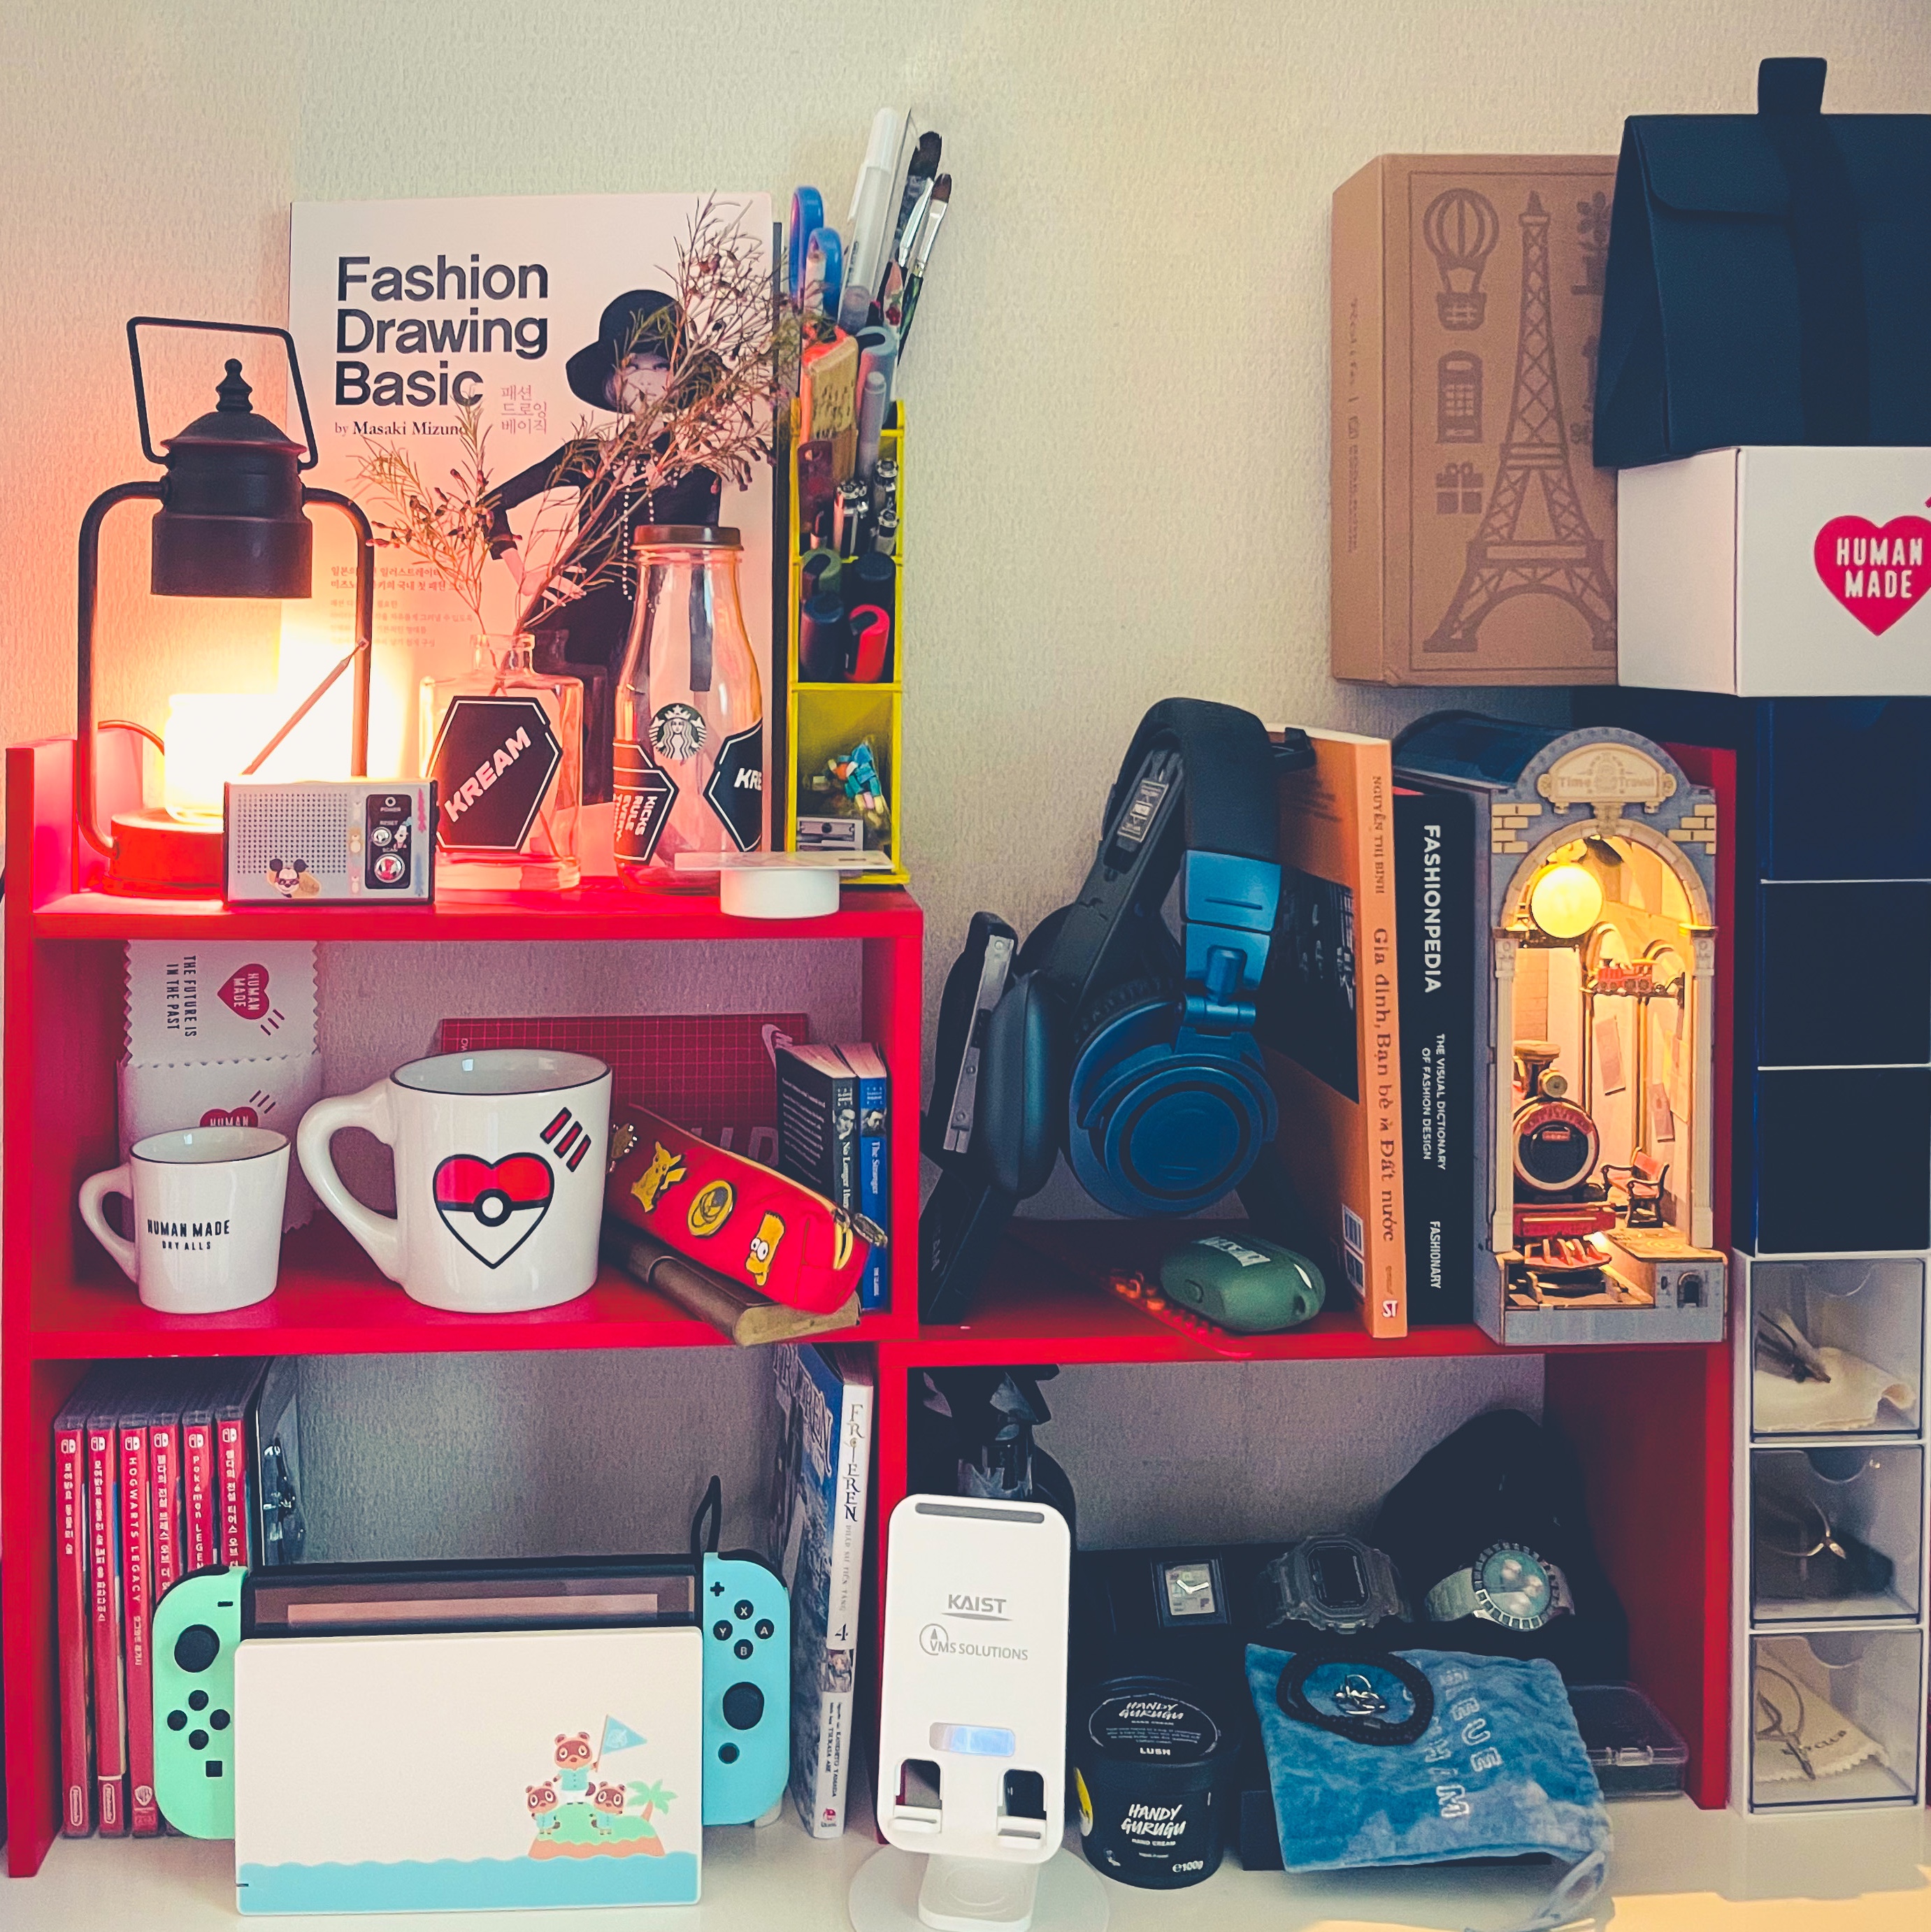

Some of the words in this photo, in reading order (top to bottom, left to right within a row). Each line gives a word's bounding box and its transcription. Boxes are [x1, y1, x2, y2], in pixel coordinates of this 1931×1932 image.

[338, 254, 549, 302] Fashion
[337, 308, 548, 360] Drawing
[336, 361, 483, 407] Basic
[501, 384, 531, 401] 패션
[501, 401, 547, 417] 드로잉
[335, 422, 348, 437] by
[353, 421, 406, 435] Masaki
[501, 418, 547, 435] 베이직
[1837, 538, 1923, 566] HUMAN
[1845, 570, 1912, 598] MADE
[443, 726, 533, 823] KREAM
[624, 795, 644, 831] RULE
[635, 795, 658, 836] KICKS
[1423, 825, 1442, 993] FASHIONPEDIA
[166, 963, 179, 975] IN
[183, 956, 196, 975] THE
[166, 979, 180, 1000] THE
[183, 979, 197, 1023] FUTURE
[233, 978, 246, 1008] MADE
[247, 972, 260, 1011] HUMAN
[166, 1004, 180, 1030] PAST
[184, 1027, 197, 1037] IS
[1436, 1033, 1445, 1055] THE
[1374, 1033, 1391, 1076] Bạn
[1421, 1047, 1431, 1064] OF
[1436, 1058, 1446, 1098] VISUAL
[1422, 1066, 1431, 1116] FASHION
[1423, 1118, 1432, 1160] DESIGN
[1436, 1101, 1447, 1170] DICTIONARY
[148, 1219, 187, 1237] HUMAN
[192, 1220, 230, 1237] MADE
[185, 1241, 211, 1250] ALLS
[1430, 1220, 1442, 1289] FASHIONARY
[1382, 1300, 1398, 1318] ST
[843, 1404, 865, 1522] FRIEREN
[129, 1457, 138, 1538] HOGWARTS
[192, 1455, 203, 1518] Pokémon
[227, 1505, 238, 1534] 티어스
[228, 1538, 238, 1557] 오브
[131, 1546, 141, 1602] LEGACY
[740, 1606, 748, 1616] X
[948, 1594, 1007, 1614] KAIST
[719, 1627, 726, 1637] Y
[760, 1626, 768, 1635] A
[835, 1623, 849, 1642] 4
[740, 1646, 747, 1656] B
[930, 1639, 956, 1654] VMS
[959, 1643, 1028, 1660] SOLUTIONS
[1126, 1701, 1179, 1711] HANDY
[1140, 1747, 1171, 1756] LUSH
[1128, 1804, 1182, 1821] HANDY
[1121, 1817, 1186, 1839] GURUGU
